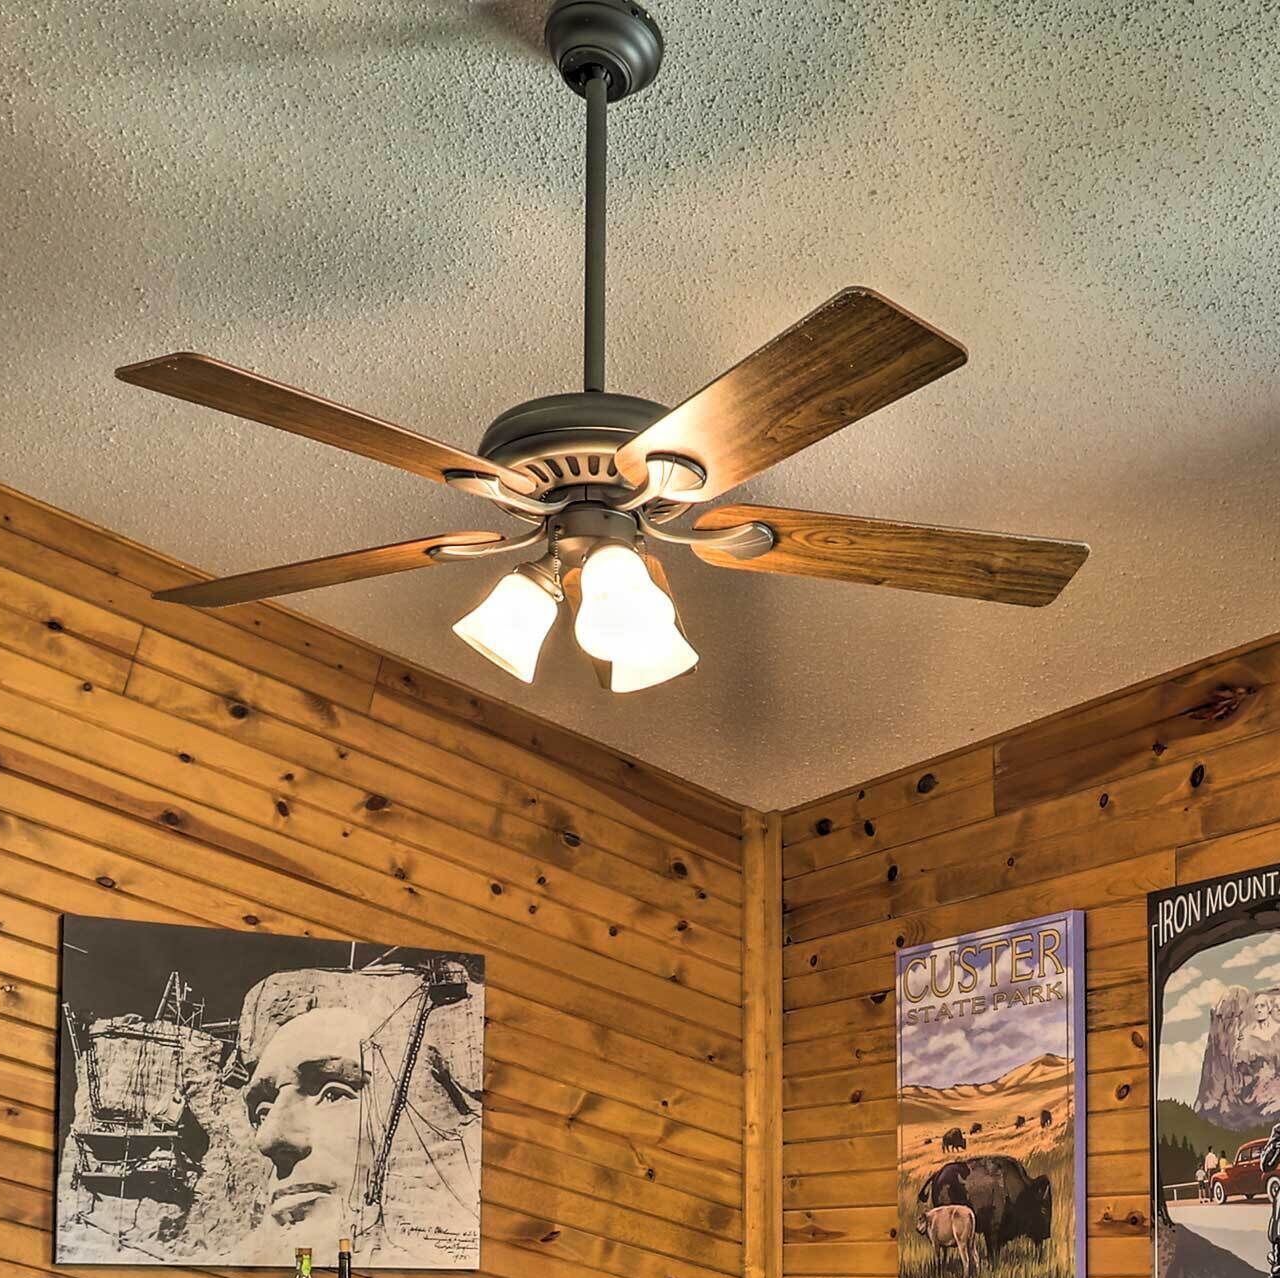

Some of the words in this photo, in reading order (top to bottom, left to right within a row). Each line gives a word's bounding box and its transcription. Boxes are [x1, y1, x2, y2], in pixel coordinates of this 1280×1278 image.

[1158, 890, 1201, 947] IRON
[903, 928, 1065, 1003] CUSTER
[906, 995, 986, 1025] STATE
[993, 981, 1064, 1011] PARK
